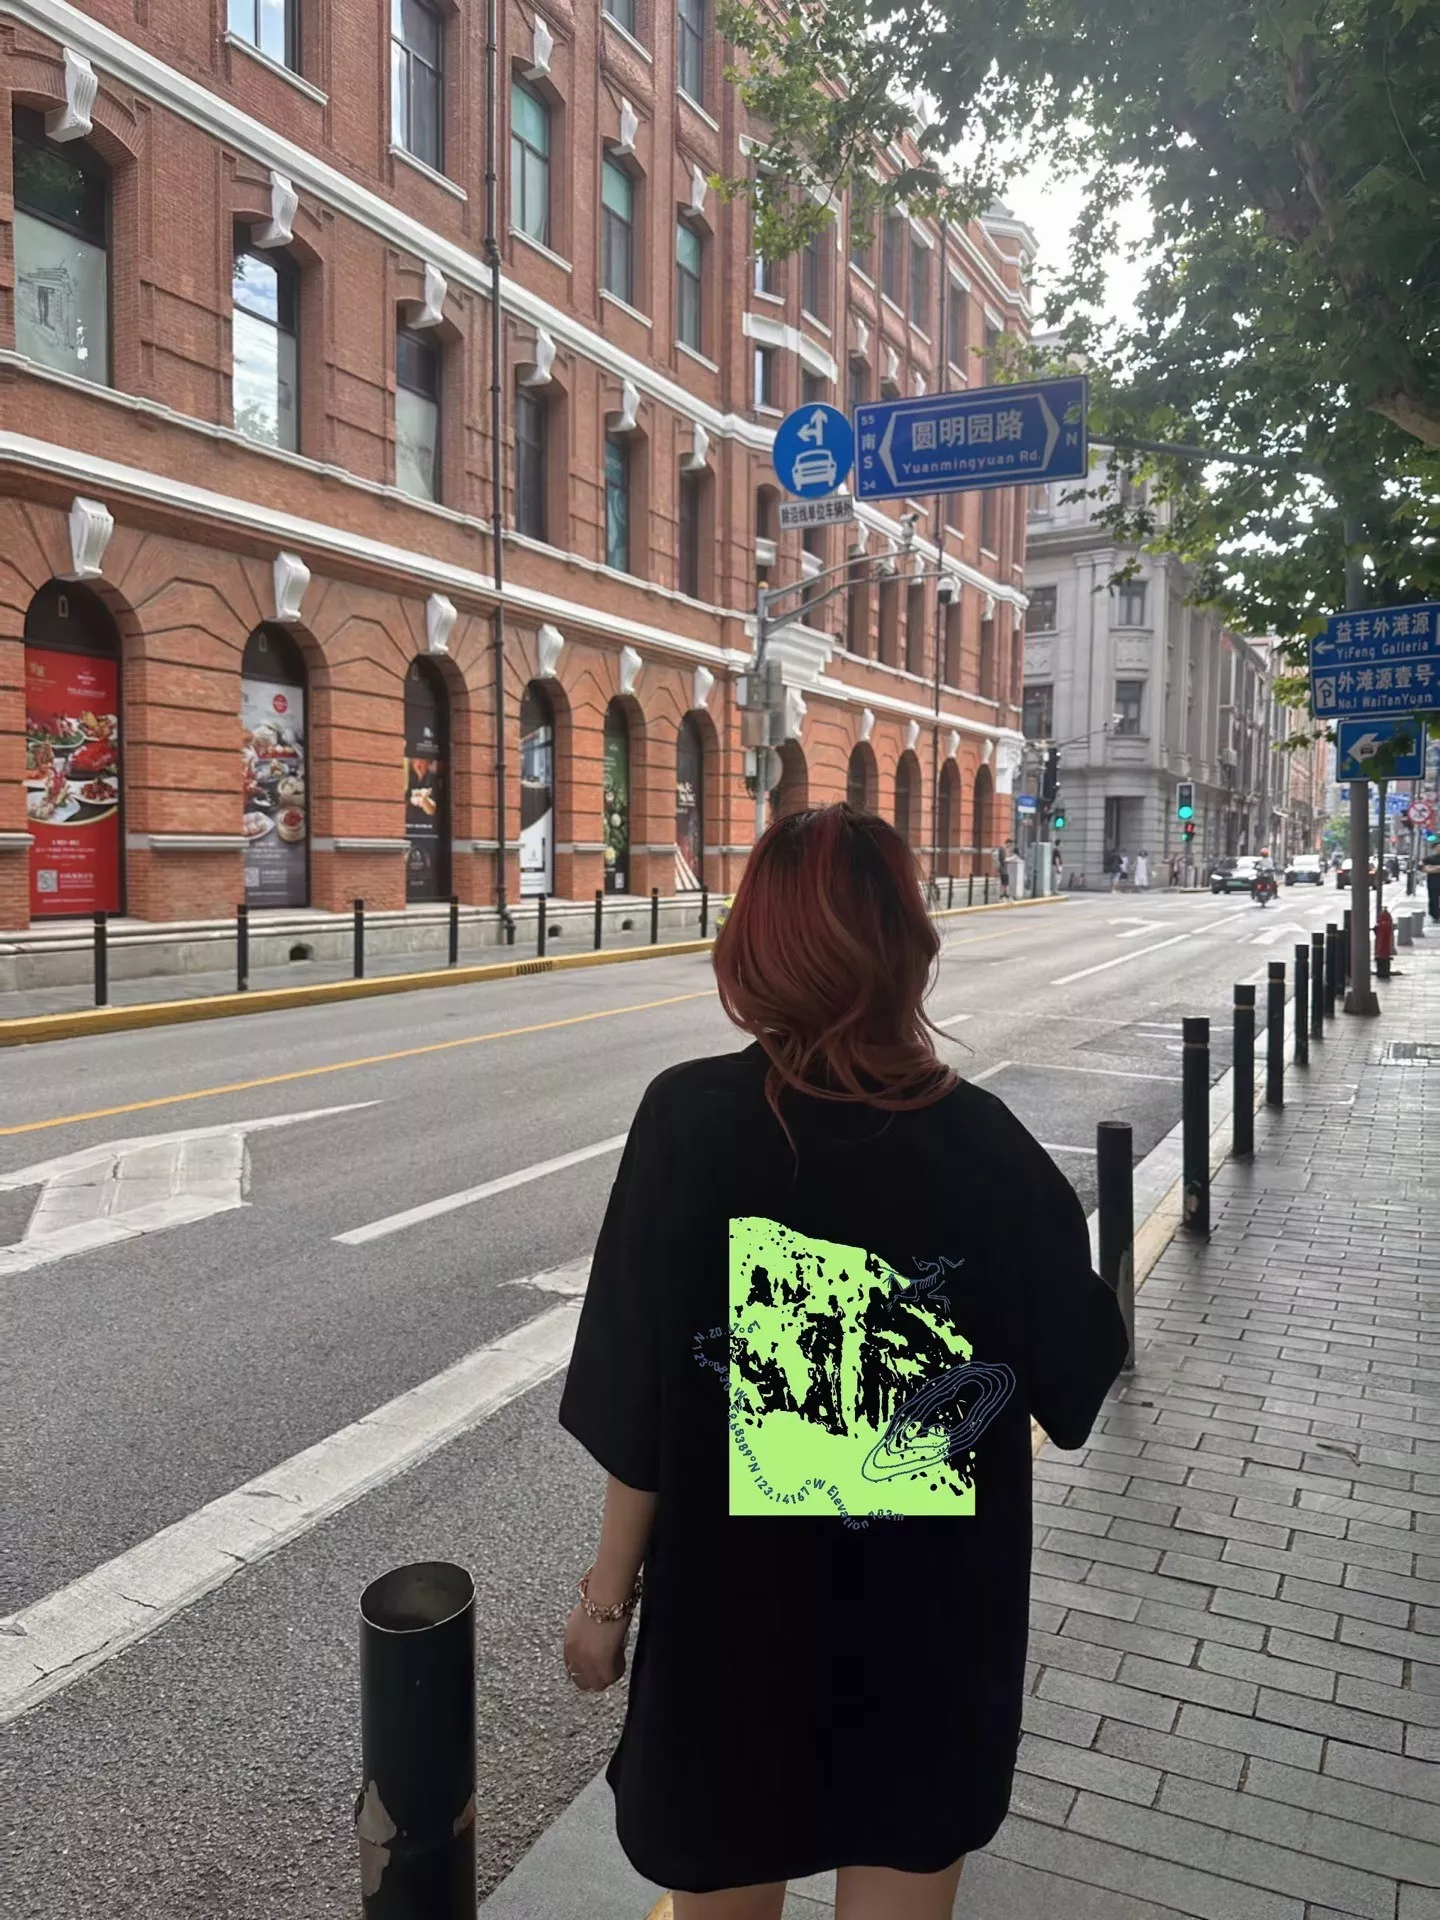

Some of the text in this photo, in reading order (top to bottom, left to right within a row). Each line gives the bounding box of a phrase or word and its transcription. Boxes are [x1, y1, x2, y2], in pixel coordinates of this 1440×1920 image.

[911, 408, 1025, 452] 圆明园路
[1066, 431, 1078, 447] N
[861, 433, 876, 452] 南
[863, 456, 873, 469] S
[903, 453, 1015, 476] Yuanmingyuan
[1335, 611, 1430, 644] 益丰外滩源
[1336, 639, 1429, 660] YiFeng Galleria
[1338, 663, 1435, 693] 外滩源壹号
[1363, 693, 1433, 709] WaiTanYuan
[827, 1485, 870, 1530] Elevation
